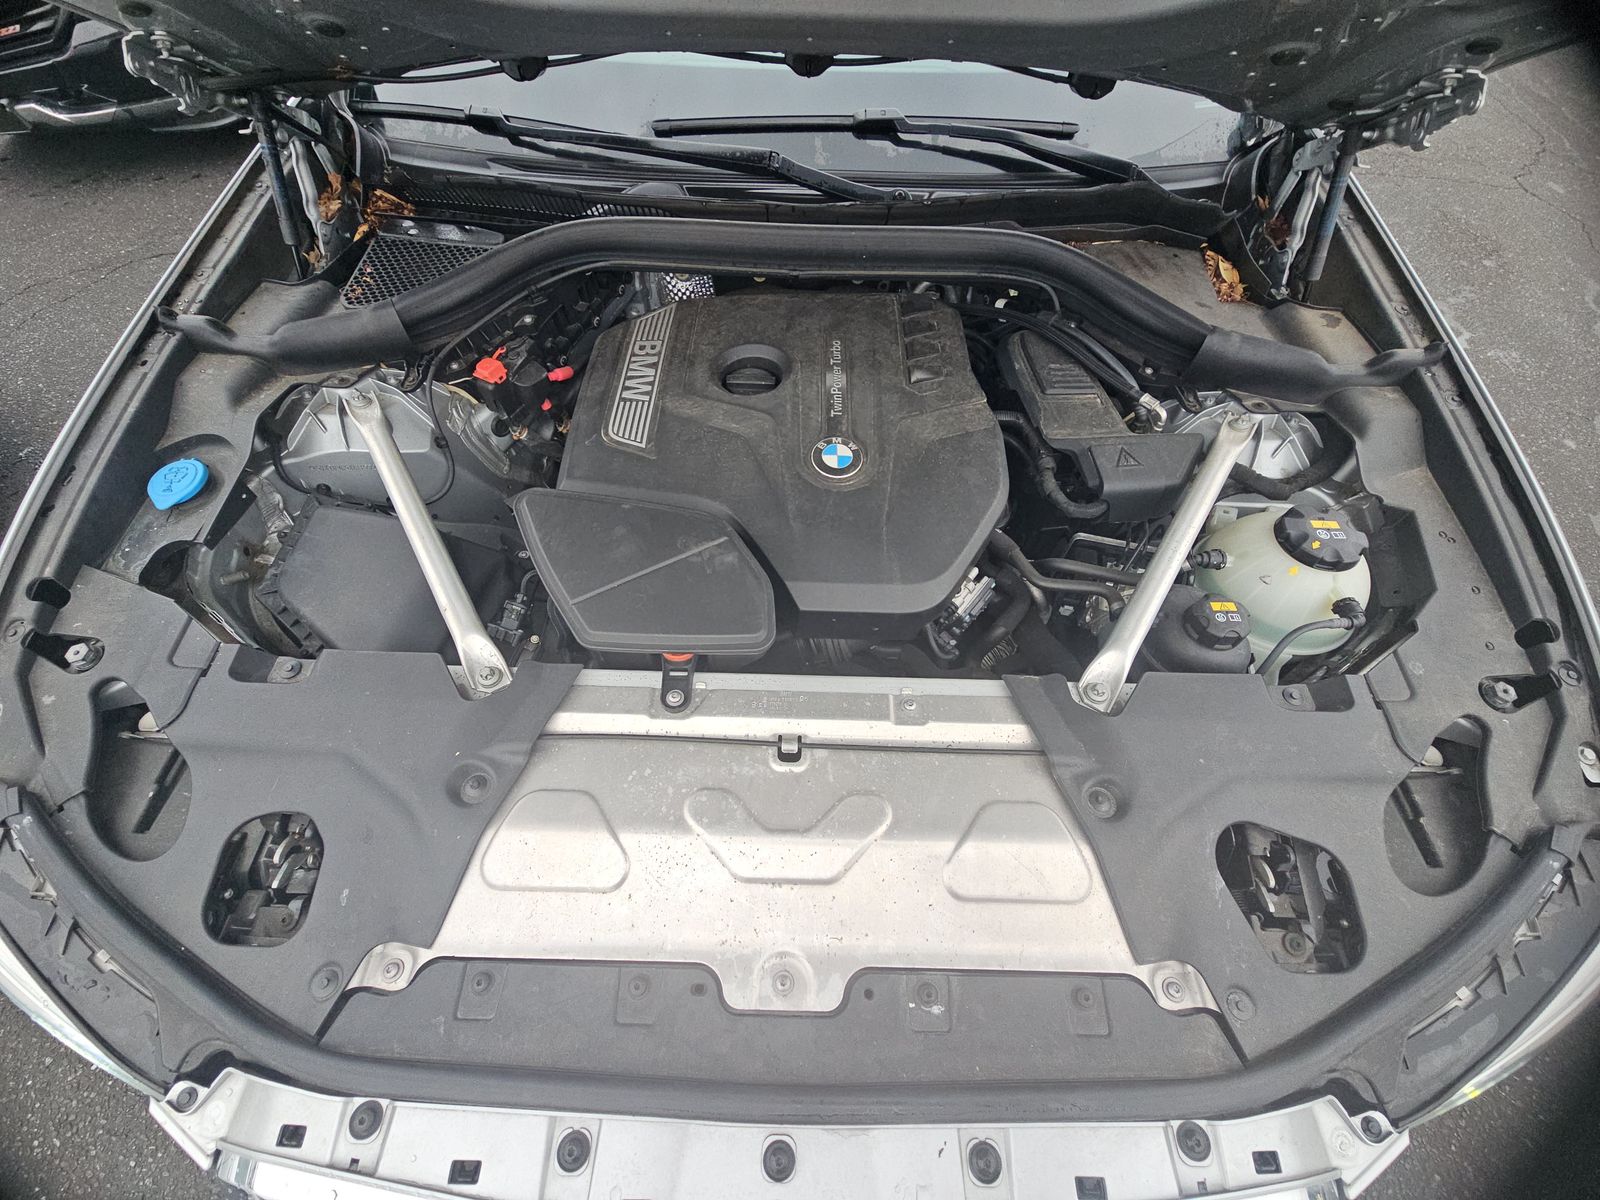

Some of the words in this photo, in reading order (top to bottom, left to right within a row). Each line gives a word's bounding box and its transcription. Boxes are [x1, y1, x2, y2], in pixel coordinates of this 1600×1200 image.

[621, 340, 663, 401] BMW
[830, 340, 842, 365] Turbo
[830, 366, 843, 417] TwinPower
[817, 437, 859, 451] BMW
